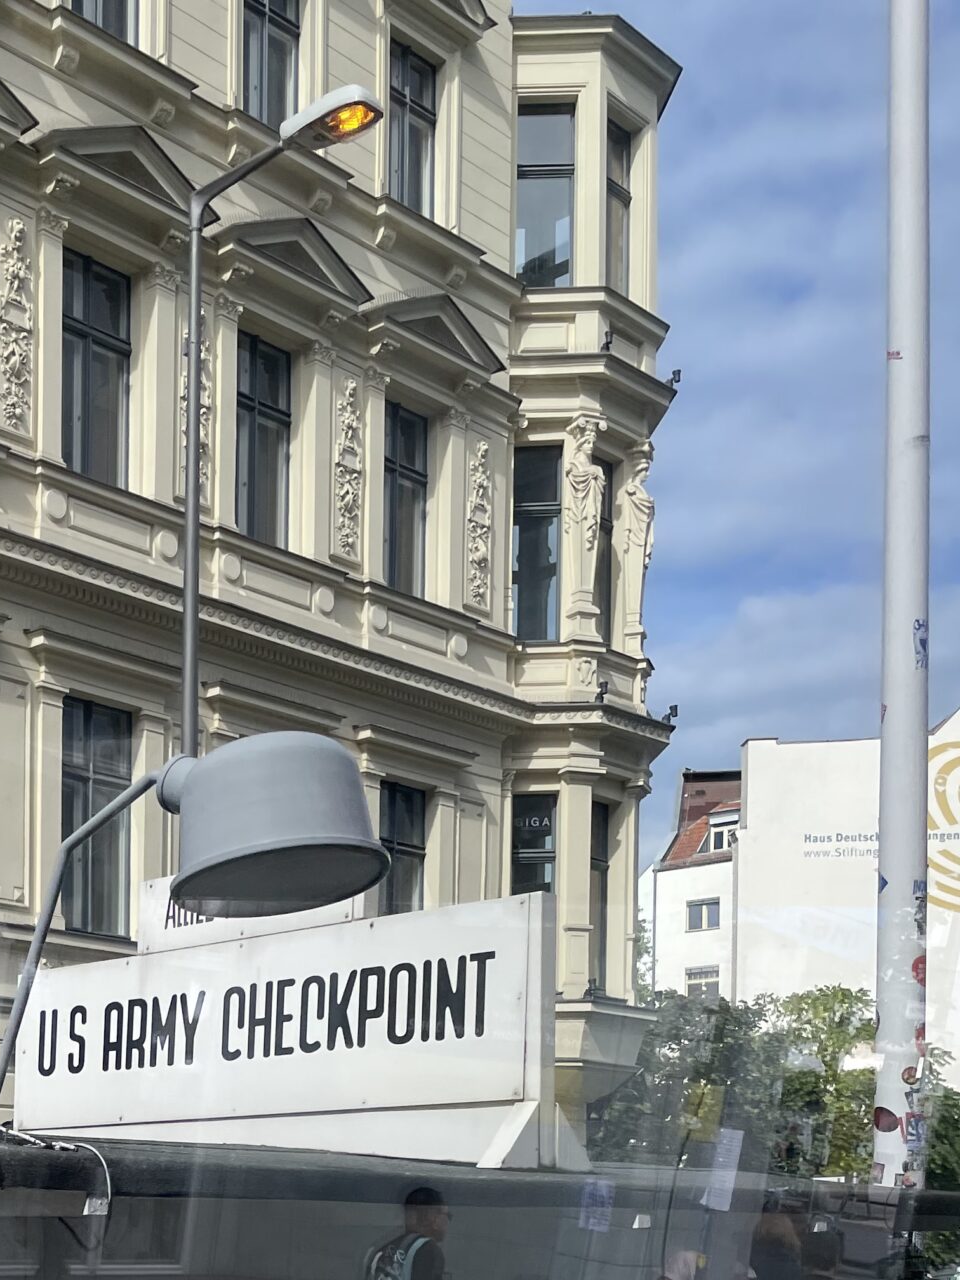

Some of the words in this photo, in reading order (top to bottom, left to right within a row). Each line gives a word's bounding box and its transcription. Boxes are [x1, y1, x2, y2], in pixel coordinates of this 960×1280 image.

[804, 833, 833, 844] Haus
[101, 990, 207, 1072] ARMY
[220, 950, 497, 1063] CHECKPOINT
